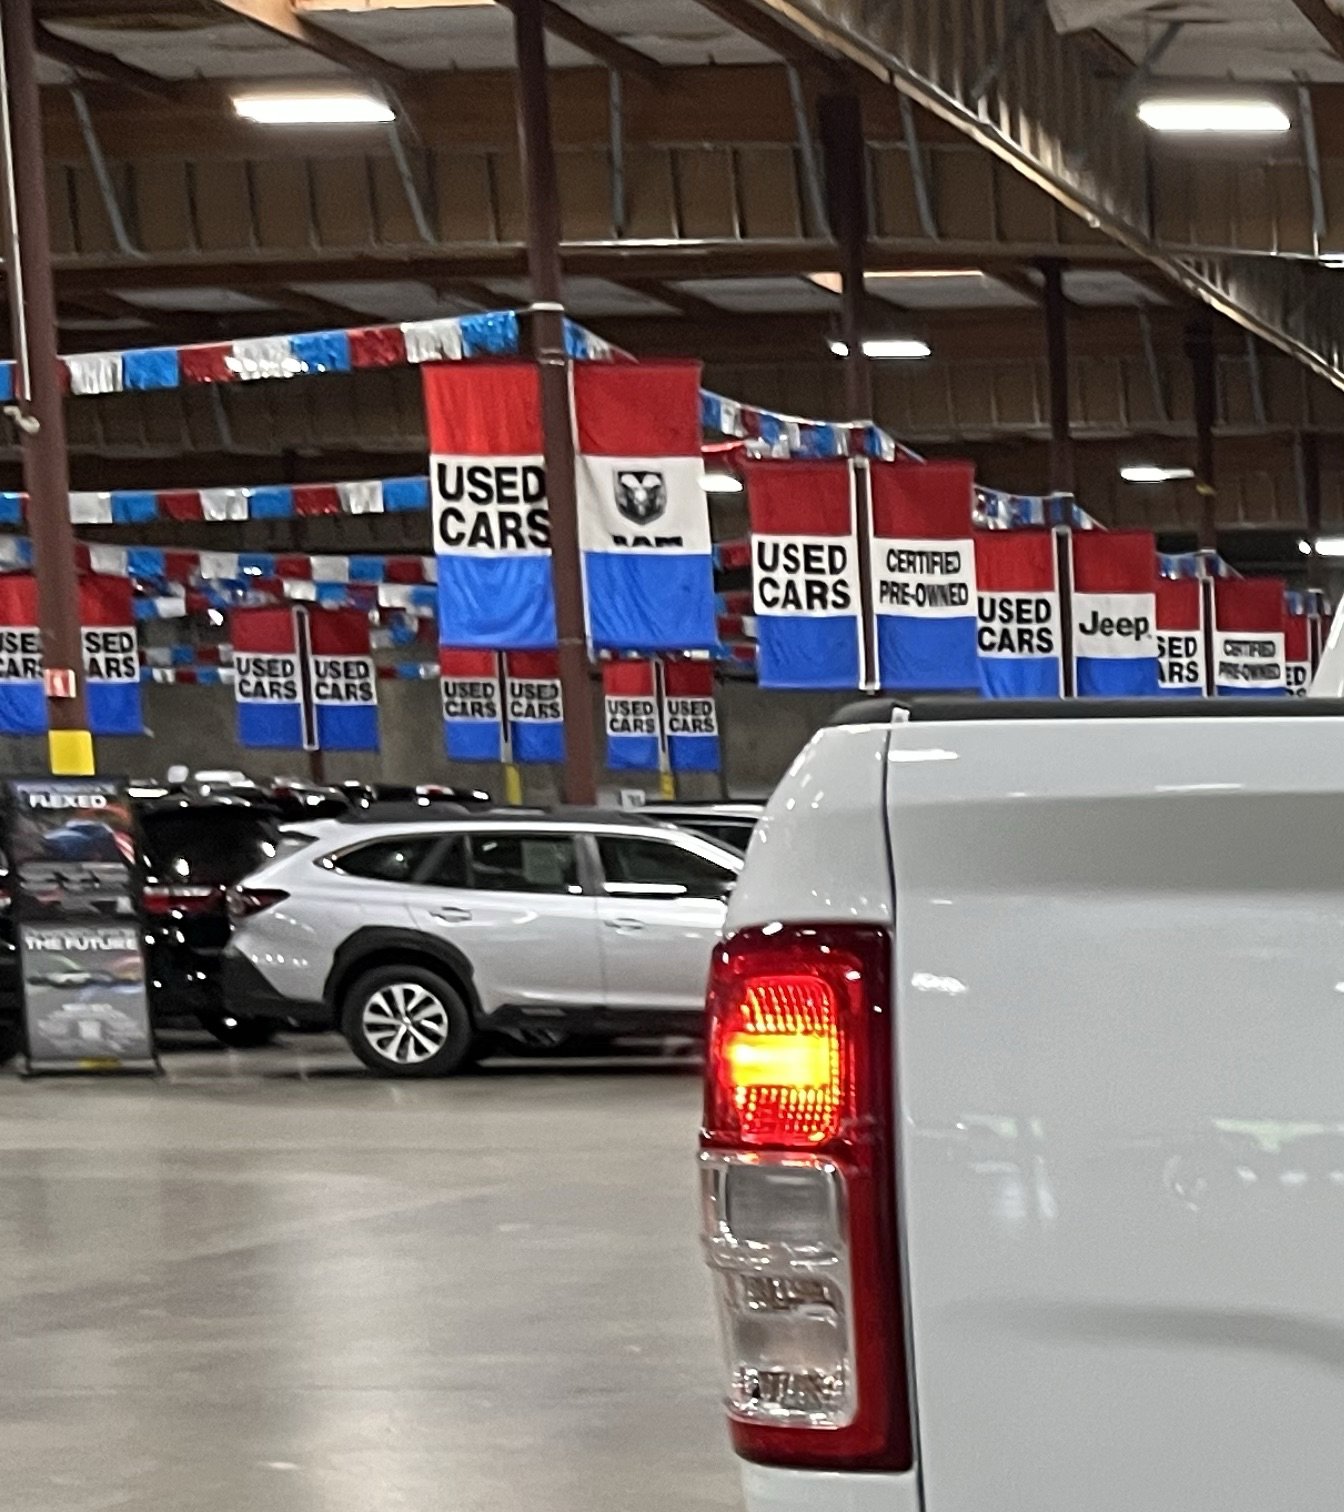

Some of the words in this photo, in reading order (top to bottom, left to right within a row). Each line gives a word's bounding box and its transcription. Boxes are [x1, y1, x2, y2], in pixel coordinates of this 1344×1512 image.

[437, 463, 548, 504] USED
[439, 507, 551, 549] CARS
[757, 541, 848, 575] USED
[886, 548, 961, 574] CERTIFIED
[758, 577, 851, 610] CARS
[879, 580, 969, 607] PRE-OWNED
[977, 596, 1051, 624] USED
[1078, 610, 1150, 641] Jeep
[85, 632, 135, 653] SED
[977, 626, 1054, 653] CARS
[88, 657, 136, 678] ARS
[236, 657, 295, 678] USED
[314, 660, 369, 679] USED
[238, 679, 297, 699] CARS
[315, 681, 373, 701] CARS
[444, 681, 495, 699] USED
[510, 682, 559, 700] USED
[445, 701, 497, 718] CARS
[510, 702, 561, 719] CARS
[608, 700, 653, 715] USED
[668, 700, 713, 716] USED
[609, 718, 656, 733] CARS
[668, 718, 715, 734] CARS
